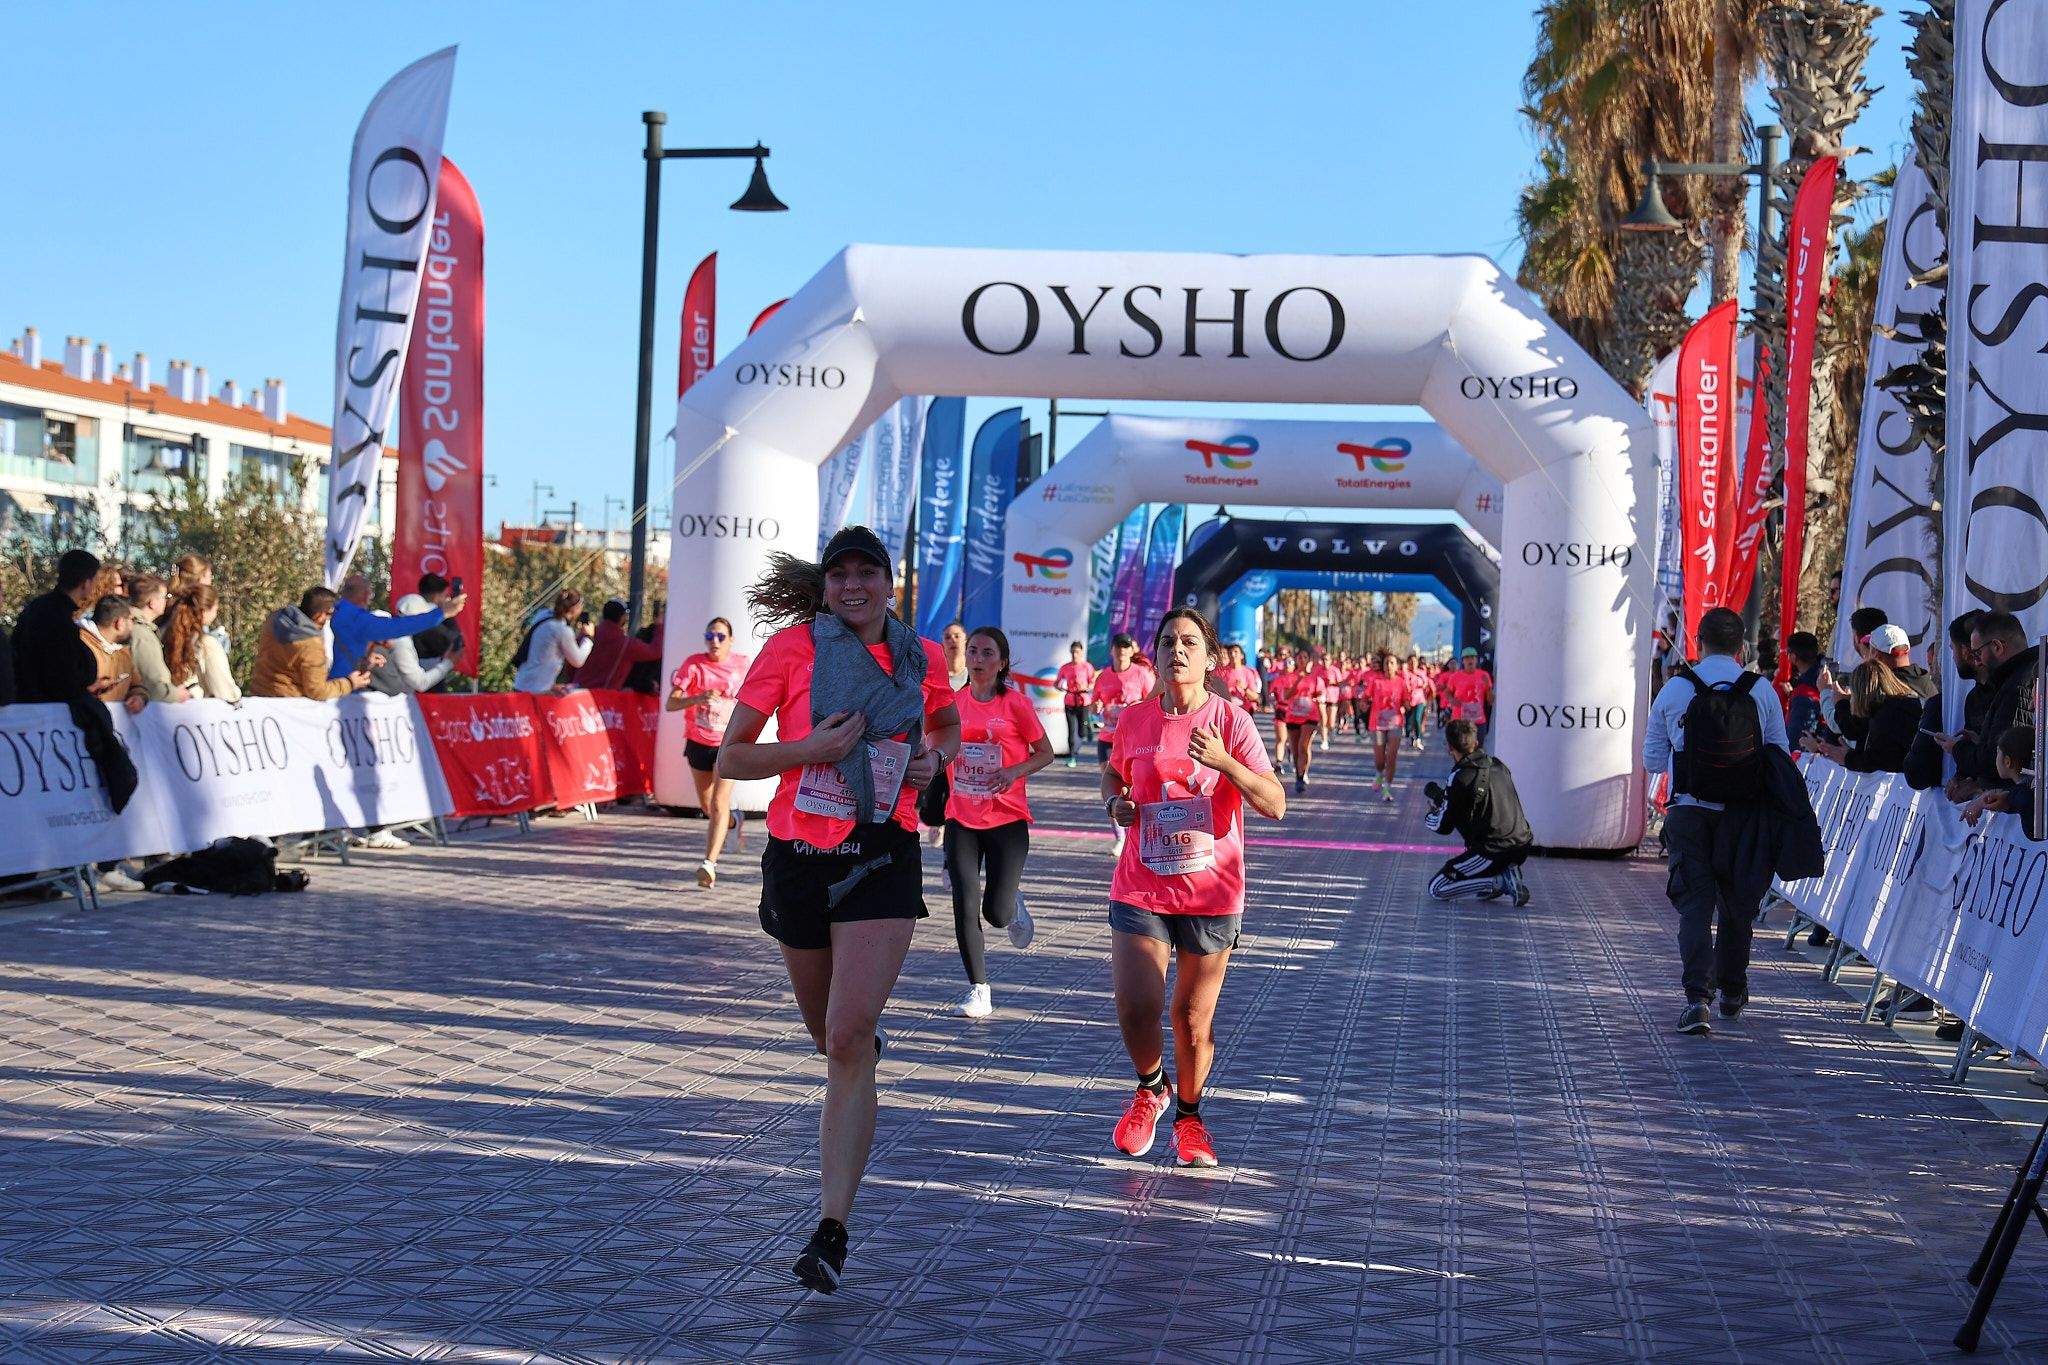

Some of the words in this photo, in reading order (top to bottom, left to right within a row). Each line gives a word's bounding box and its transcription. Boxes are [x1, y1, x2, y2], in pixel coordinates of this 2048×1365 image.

[962, 282, 1345, 361] OYSHO
[736, 364, 845, 390] OYSHO
[1460, 375, 1578, 400] OYSHO
[1697, 359, 1718, 529] Santander
[1184, 474, 1258, 488] TotalEnergies
[1336, 478, 1411, 490] TotalEnergies
[679, 514, 780, 541] OYSHO
[967, 474, 1005, 575] Marlene
[1263, 536, 1419, 556] VOLVO
[1522, 542, 1632, 568] OYSHO
[1011, 583, 1072, 596] TotalEnergies
[1517, 703, 1626, 729] OYSHO
[173, 716, 289, 782] OYSHO
[326, 716, 414, 769] OYSHO
[1162, 833, 1191, 846] 016
[1952, 833, 2048, 938] OYSHO
